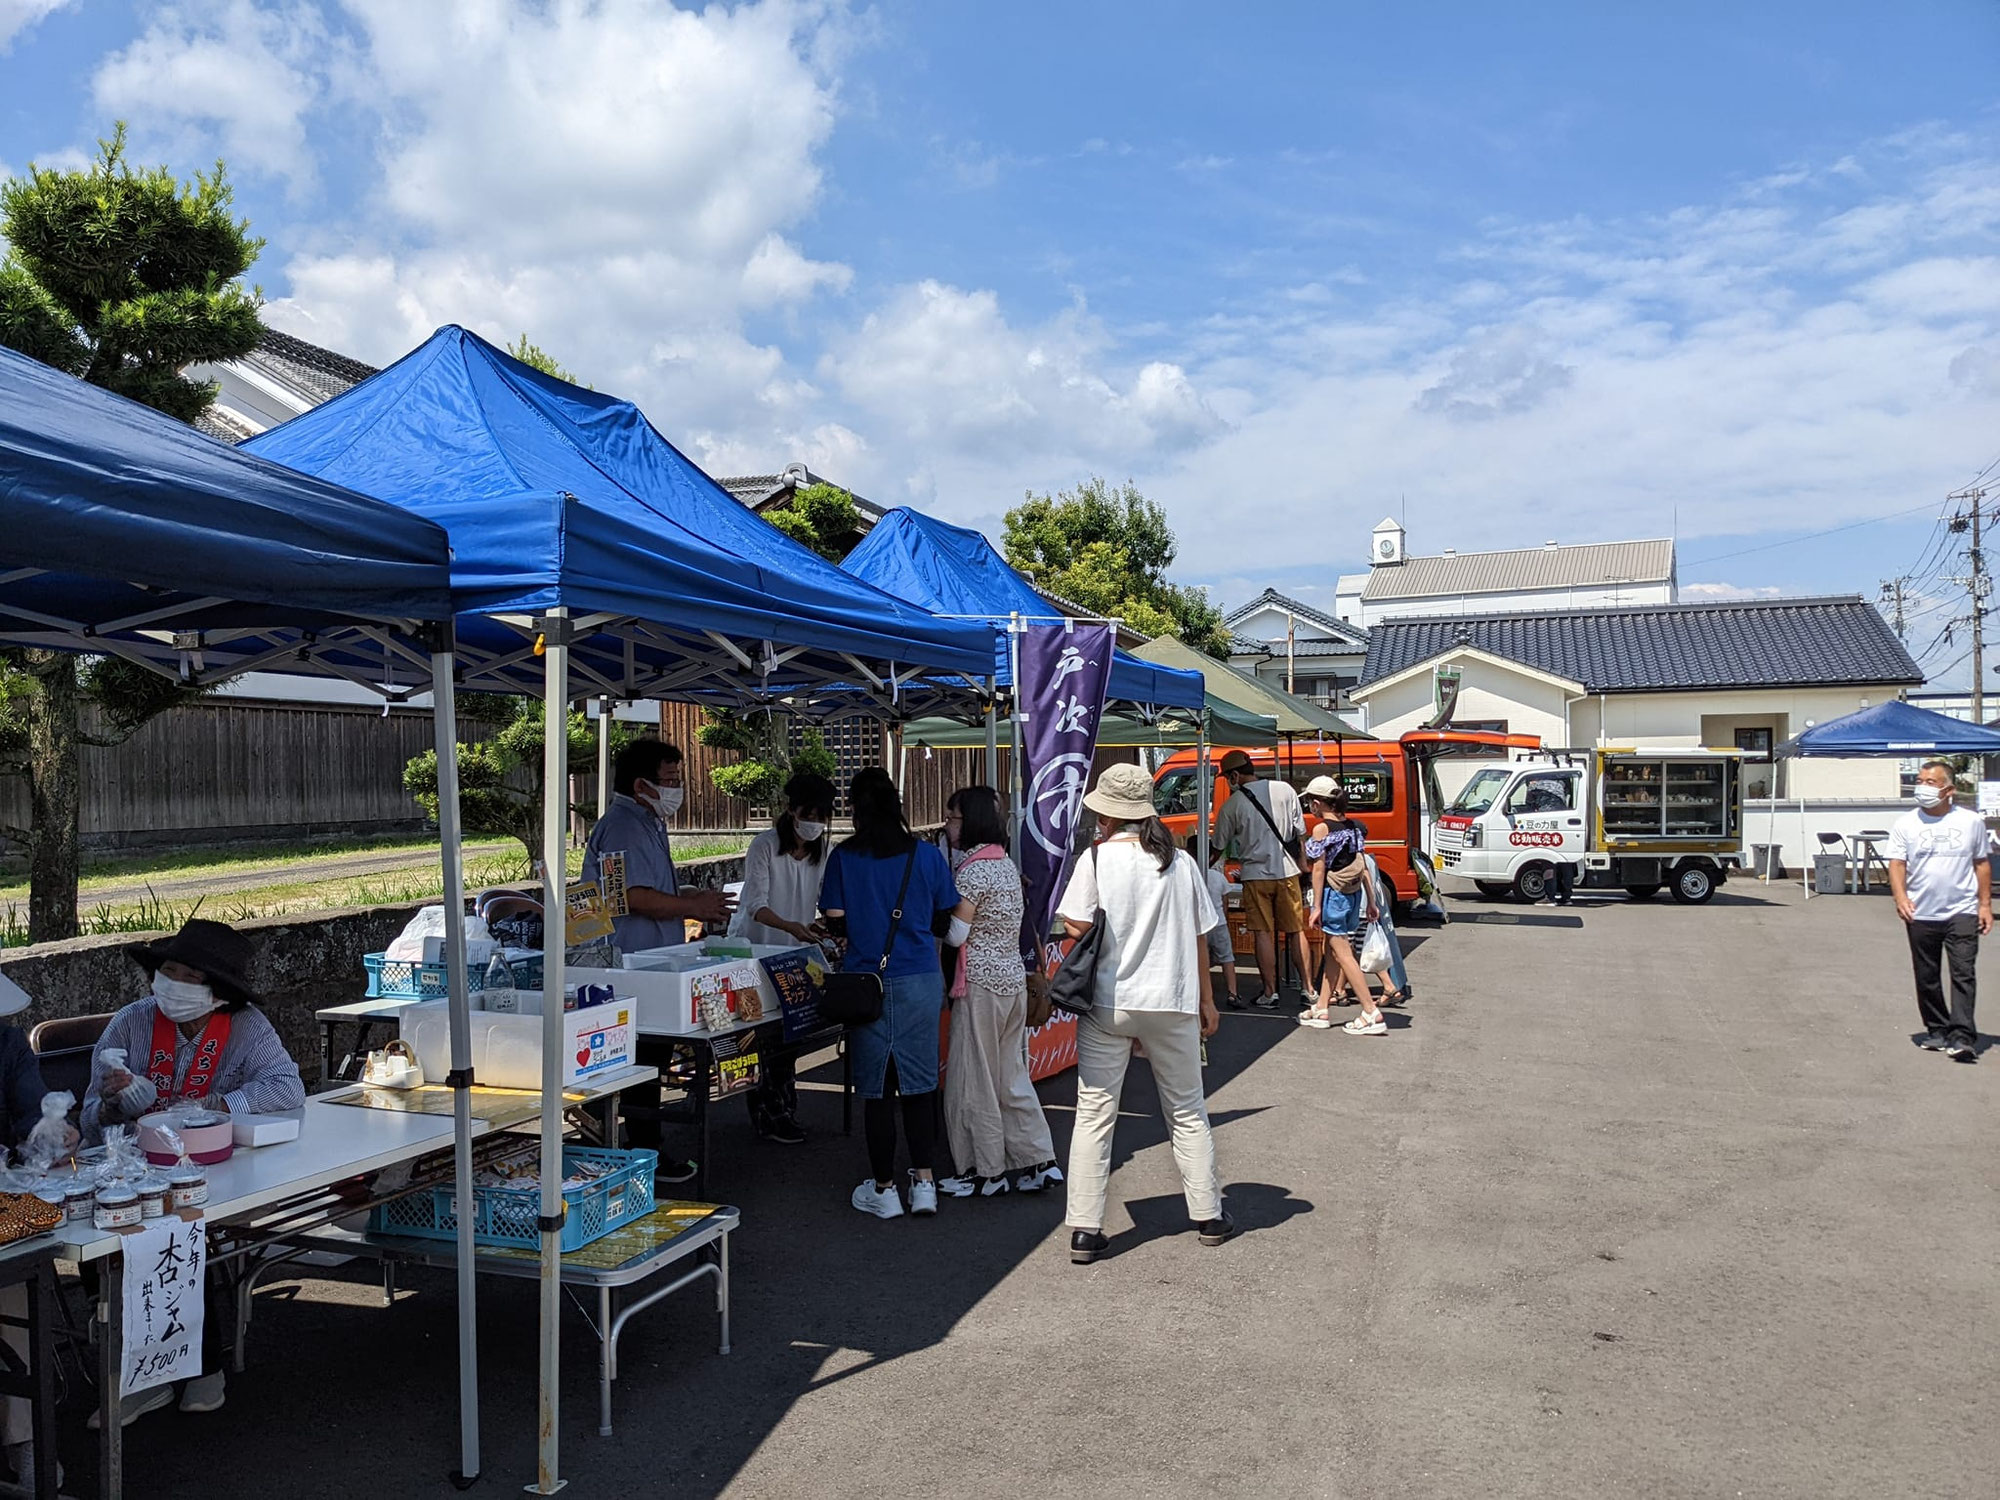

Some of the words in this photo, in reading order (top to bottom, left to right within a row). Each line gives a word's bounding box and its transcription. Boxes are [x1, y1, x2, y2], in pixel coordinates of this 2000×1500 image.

[1053, 646, 1089, 737] 戸次
[1510, 833, 1561, 846] 移動販売車
[1526, 820, 1559, 830] 豆の力屋
[153, 1232, 186, 1343] 杏ジャム
[187, 1222, 203, 1291] 今年の
